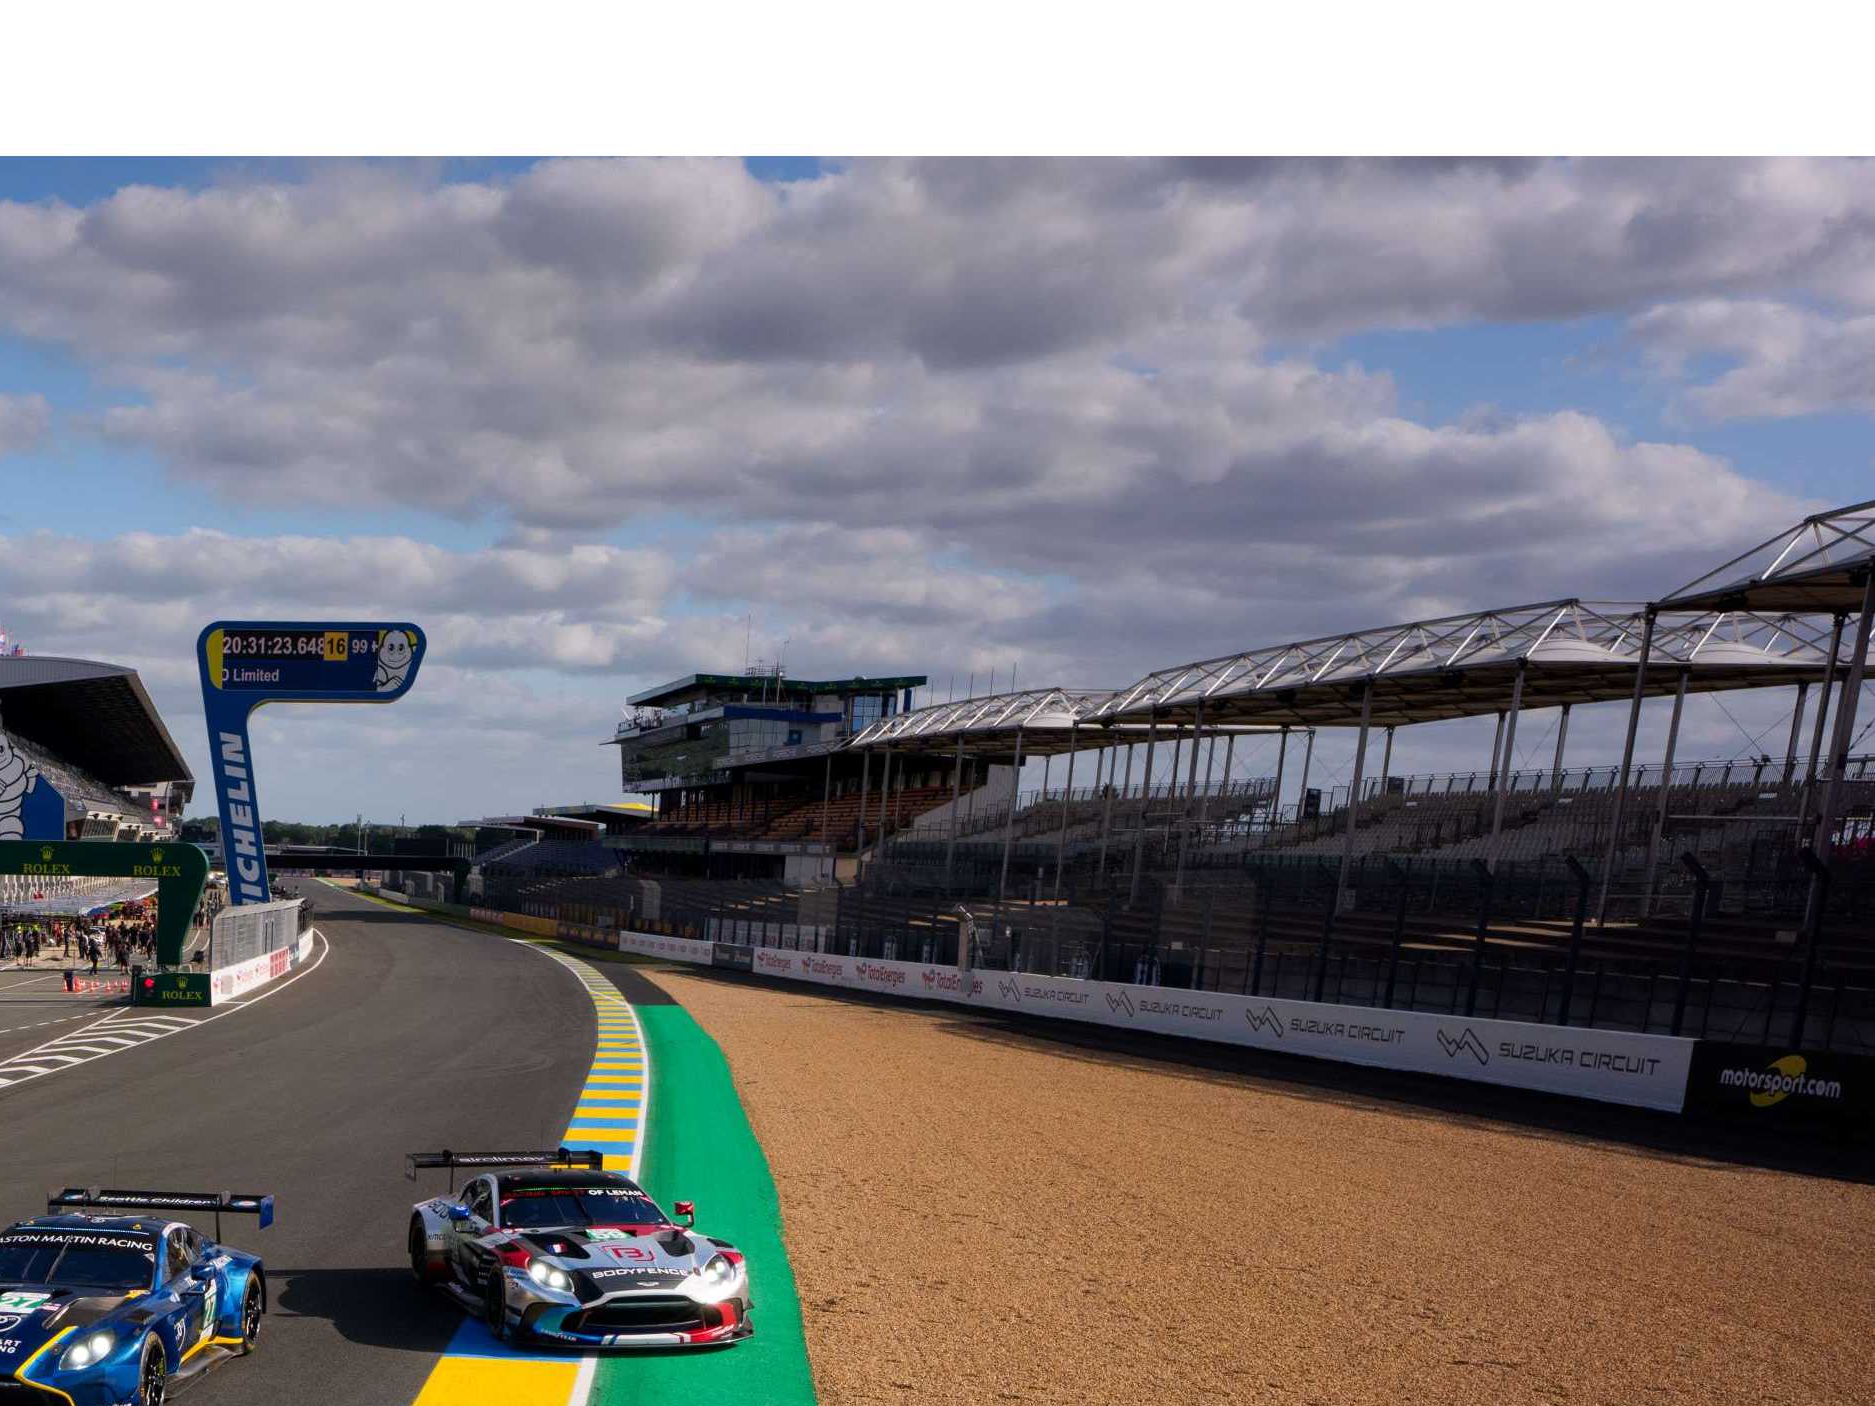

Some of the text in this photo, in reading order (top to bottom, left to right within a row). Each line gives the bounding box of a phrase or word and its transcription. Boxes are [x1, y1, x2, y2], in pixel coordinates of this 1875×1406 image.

[327, 638, 346, 654] 16
[352, 640, 367, 654] 99
[234, 669, 279, 682] Limited
[219, 731, 263, 904] ICHELIN
[24, 863, 70, 874] ROLEX
[134, 865, 180, 876] ROLEX
[162, 991, 202, 1000] ROLEX
[1140, 1000, 1223, 1021] SUZUKA CIRCUIT
[1290, 1018, 1406, 1044] SUZUKA CIRCUIT
[1499, 1042, 1661, 1076] SUZUKA CIRCUIT
[1720, 1066, 1841, 1099] motorsport.com
[41, 1235, 95, 1244] MARTIN
[97, 1238, 153, 1250] RACING
[592, 1267, 688, 1279] BODYFENCE
